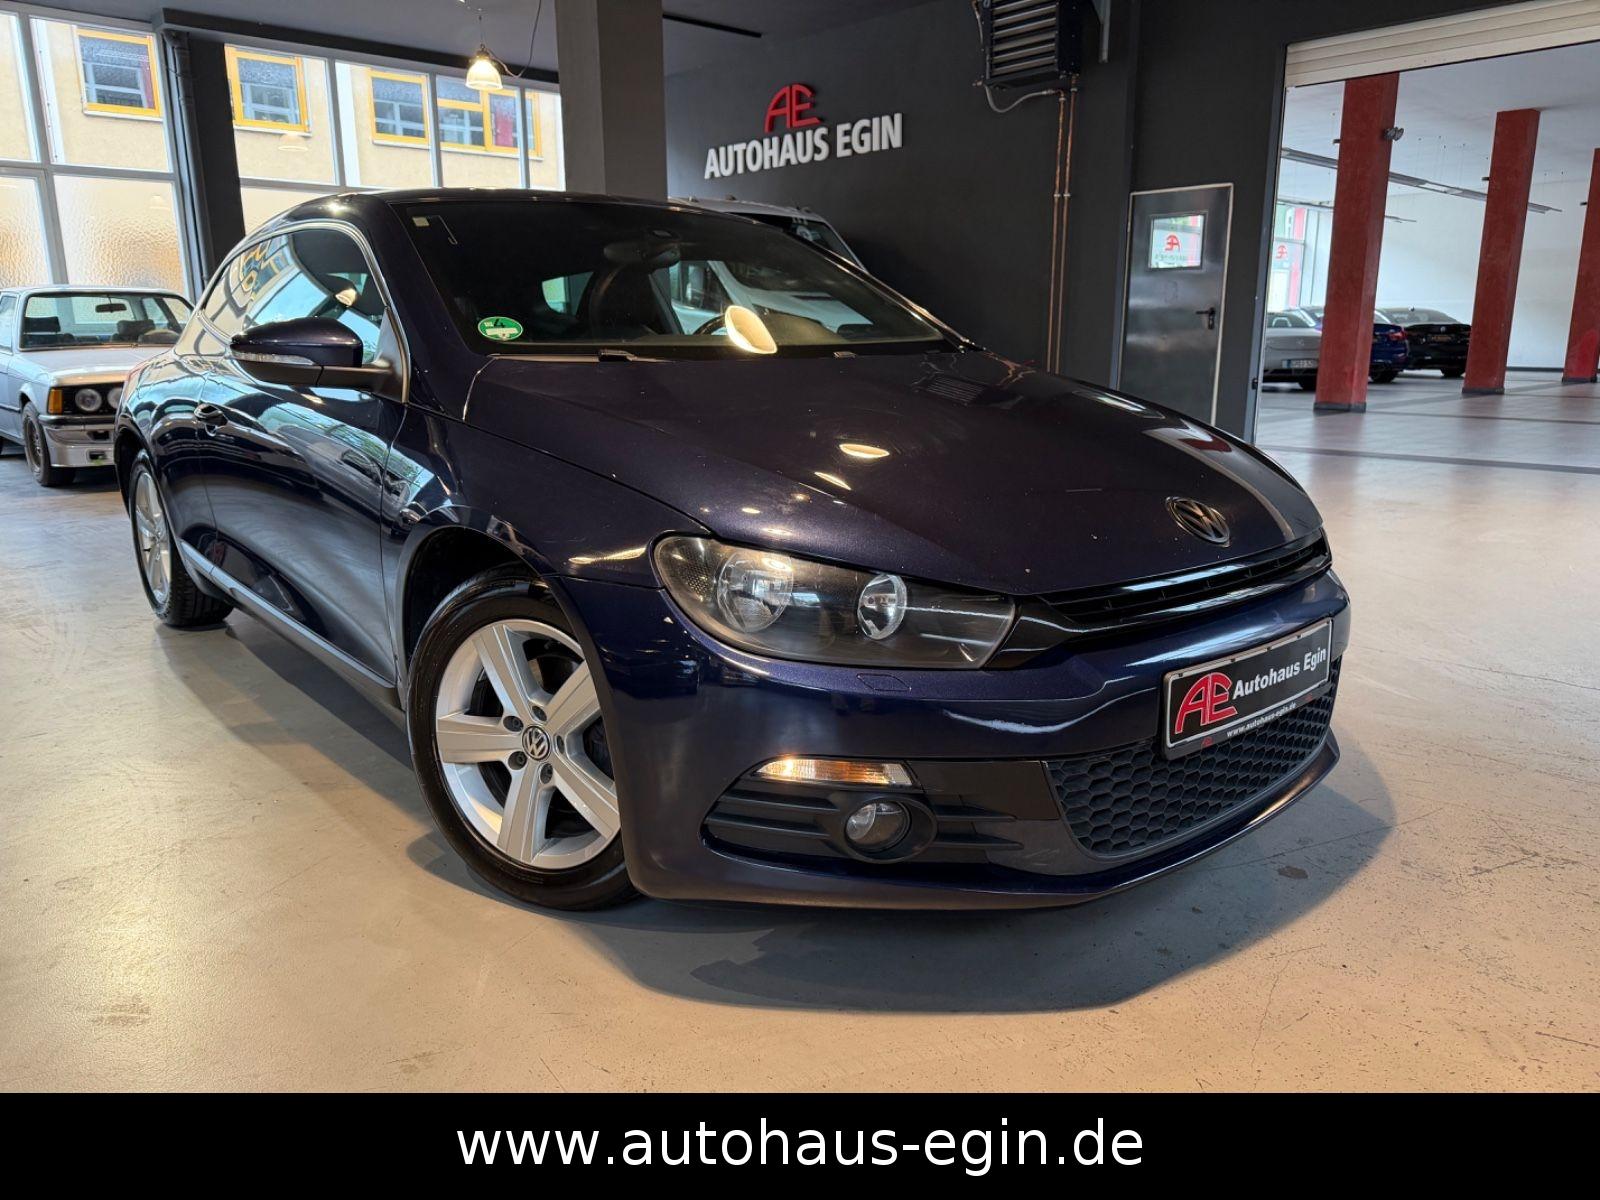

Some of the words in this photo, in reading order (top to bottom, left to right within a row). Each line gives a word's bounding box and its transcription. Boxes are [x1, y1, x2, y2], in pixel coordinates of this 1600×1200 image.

[704, 127, 828, 179] AUTOHAUS
[836, 113, 903, 158] EGIN
[1233, 660, 1301, 700] Autohaus
[1303, 647, 1327, 674] Egin
[1226, 701, 1297, 737] www.autohaus-egin.de
